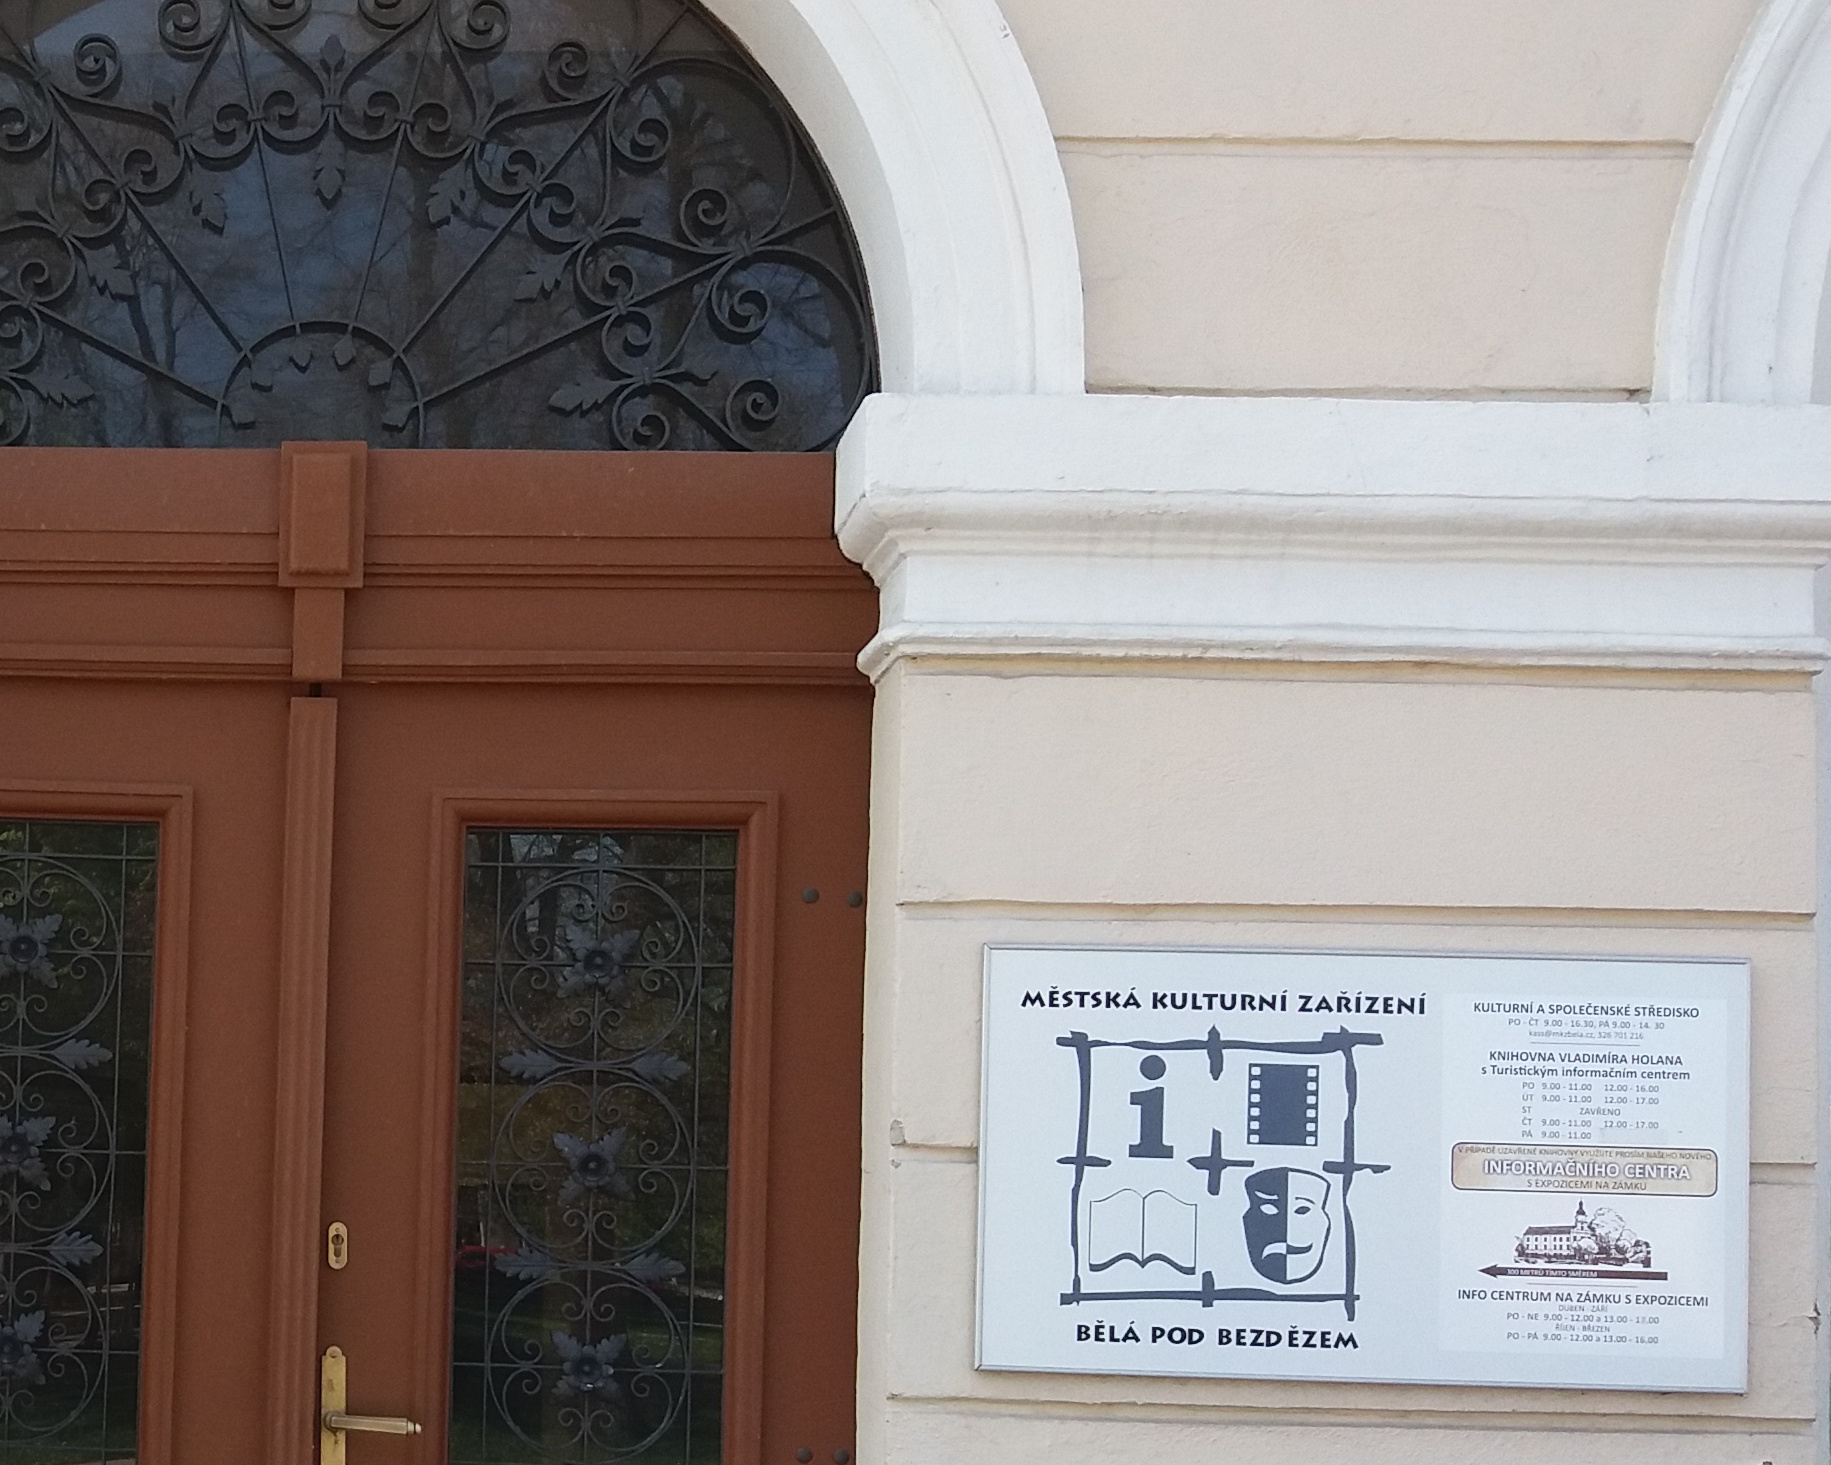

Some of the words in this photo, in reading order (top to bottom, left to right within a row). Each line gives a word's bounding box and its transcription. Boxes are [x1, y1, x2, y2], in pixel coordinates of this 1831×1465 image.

[1021, 986, 1141, 1009] MĚSTSKÁ
[1152, 990, 1287, 1011] KULTURNÍ
[1298, 991, 1426, 1014] ZAŘÍZENÍ
[1474, 1002, 1533, 1013] KULTURNÍ
[1537, 1004, 1545, 1014] A
[1549, 1003, 1630, 1016] SPOLEČENSKÉ
[1634, 1005, 1699, 1018] STŘEDISKO
[1544, 1019, 1562, 1027] 9.00
[1612, 1021, 1630, 1029] 9.00
[1490, 1051, 1555, 1062] KNIHOVNA
[1559, 1052, 1627, 1064] VLADIMÍRA
[1632, 1055, 1683, 1065] HOLANA
[1490, 1065, 1558, 1078] Turistickým
[1562, 1067, 1637, 1078] informačním
[1641, 1070, 1690, 1080] centrem
[1569, 1083, 1592, 1091] 11.00
[1605, 1084, 1628, 1092] 12.00
[1569, 1095, 1592, 1103] 11.00
[1579, 1107, 1620, 1116] ZAVŘENO
[1522, 1117, 1532, 1126] ČT
[1636, 1121, 1659, 1129] 17.00
[1522, 1130, 1533, 1138] PÁ
[1483, 1158, 1619, 1179] INFORMAČNÍHO
[1624, 1163, 1691, 1180] CENTRA
[1527, 1179, 1532, 1187] S
[1535, 1180, 1593, 1189] EXPOZICEMI
[1595, 1181, 1609, 1189] NA
[1612, 1179, 1647, 1191] ZÁMKU
[1458, 1289, 1487, 1300] INFO
[1491, 1291, 1551, 1302] CENTRUM
[1556, 1293, 1573, 1302] NA
[1577, 1289, 1621, 1303] ZÁMKU
[1625, 1294, 1631, 1304] S
[1636, 1295, 1708, 1306] EXPOZICEMI
[1507, 1312, 1519, 1320] PO
[1544, 1314, 1563, 1322] 9.00
[1571, 1314, 1594, 1322] 12.00
[1077, 1320, 1140, 1343] BĚLÁ
[1149, 1327, 1204, 1345] POD
[1218, 1323, 1358, 1349] BEZDĚZEM
[1507, 1332, 1519, 1340] PO
[1543, 1333, 1561, 1341] 9.00
[1570, 1334, 1593, 1342] 12.00
[1604, 1335, 1627, 1343] 13.00
